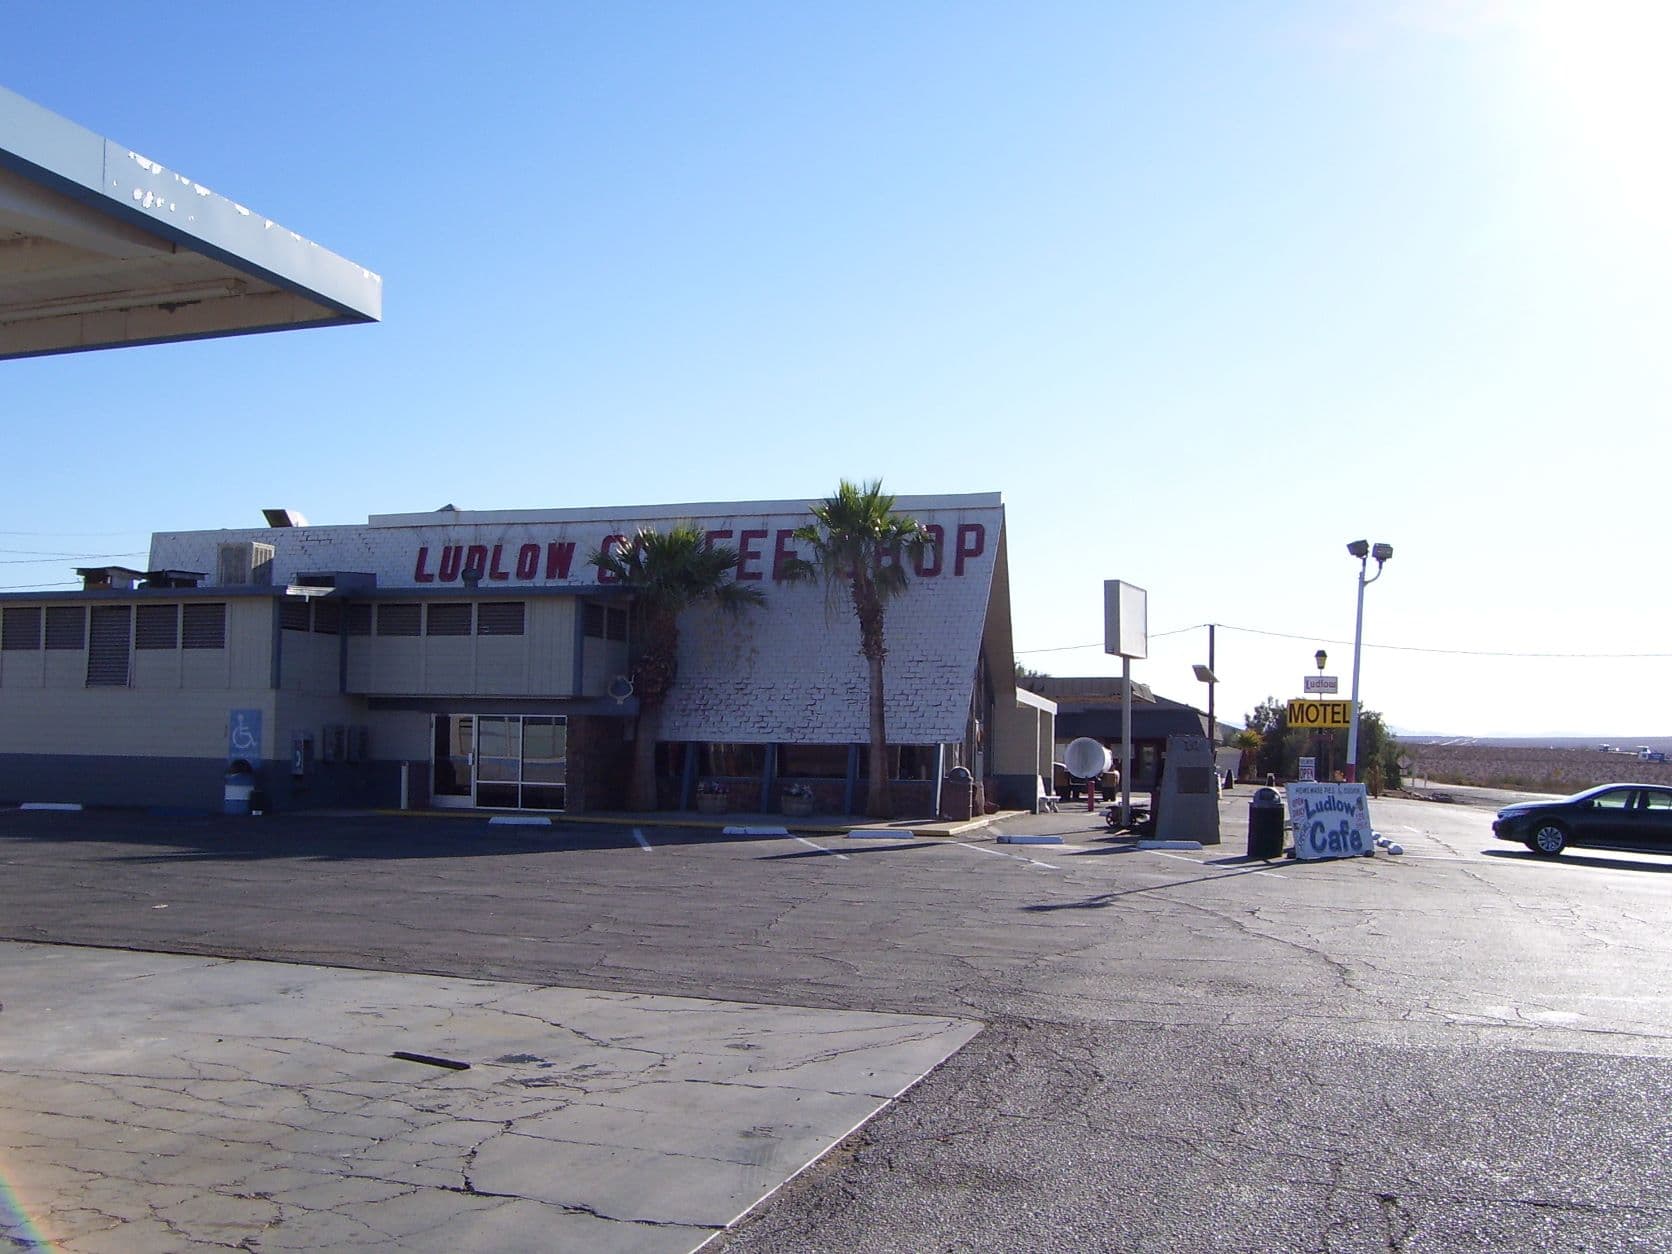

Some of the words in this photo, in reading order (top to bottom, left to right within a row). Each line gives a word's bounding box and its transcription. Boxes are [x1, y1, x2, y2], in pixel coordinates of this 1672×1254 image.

[414, 542, 576, 583] LUDLOW
[1305, 679, 1337, 690] Ludlow
[1288, 703, 1350, 724] MOTEL
[1304, 795, 1355, 819] Ludlow
[1310, 820, 1363, 853] Cafe
